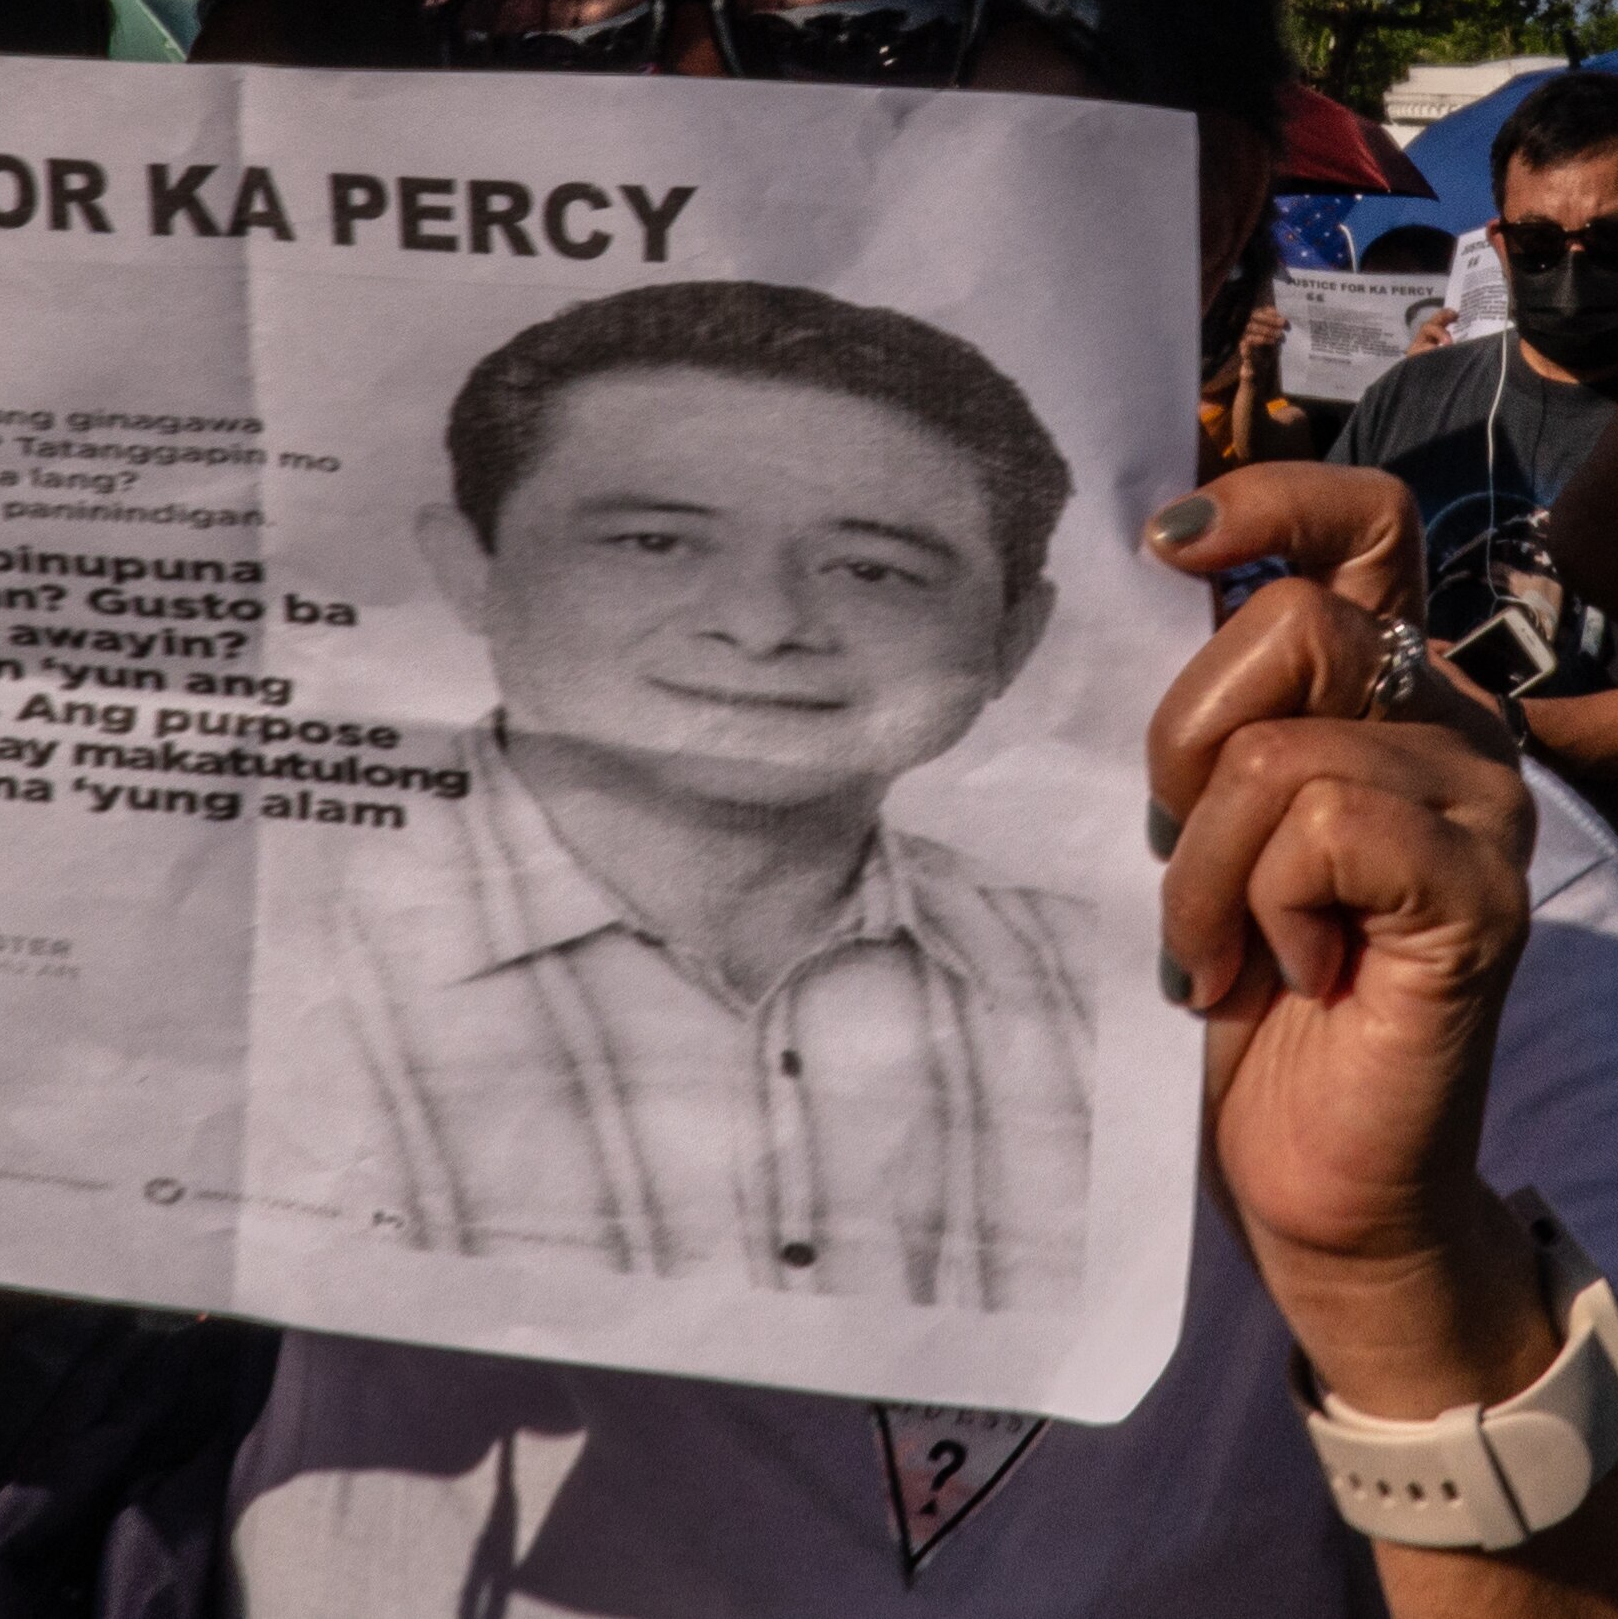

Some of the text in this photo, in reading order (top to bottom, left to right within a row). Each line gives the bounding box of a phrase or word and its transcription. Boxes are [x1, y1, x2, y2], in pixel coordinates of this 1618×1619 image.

[147, 162, 296, 243] KA
[328, 171, 699, 263] PERCY
[1341, 283, 1366, 294] FOR
[1369, 285, 1388, 294] KA
[1391, 286, 1434, 296] PERCY
[87, 586, 266, 623] Gusto
[284, 593, 358, 627] ba
[9, 622, 249, 661] awayin?
[185, 670, 295, 707] ang
[15, 692, 138, 735] Ang
[154, 706, 402, 750] purpose
[71, 740, 472, 800] makatutulong
[260, 789, 408, 830] alam
